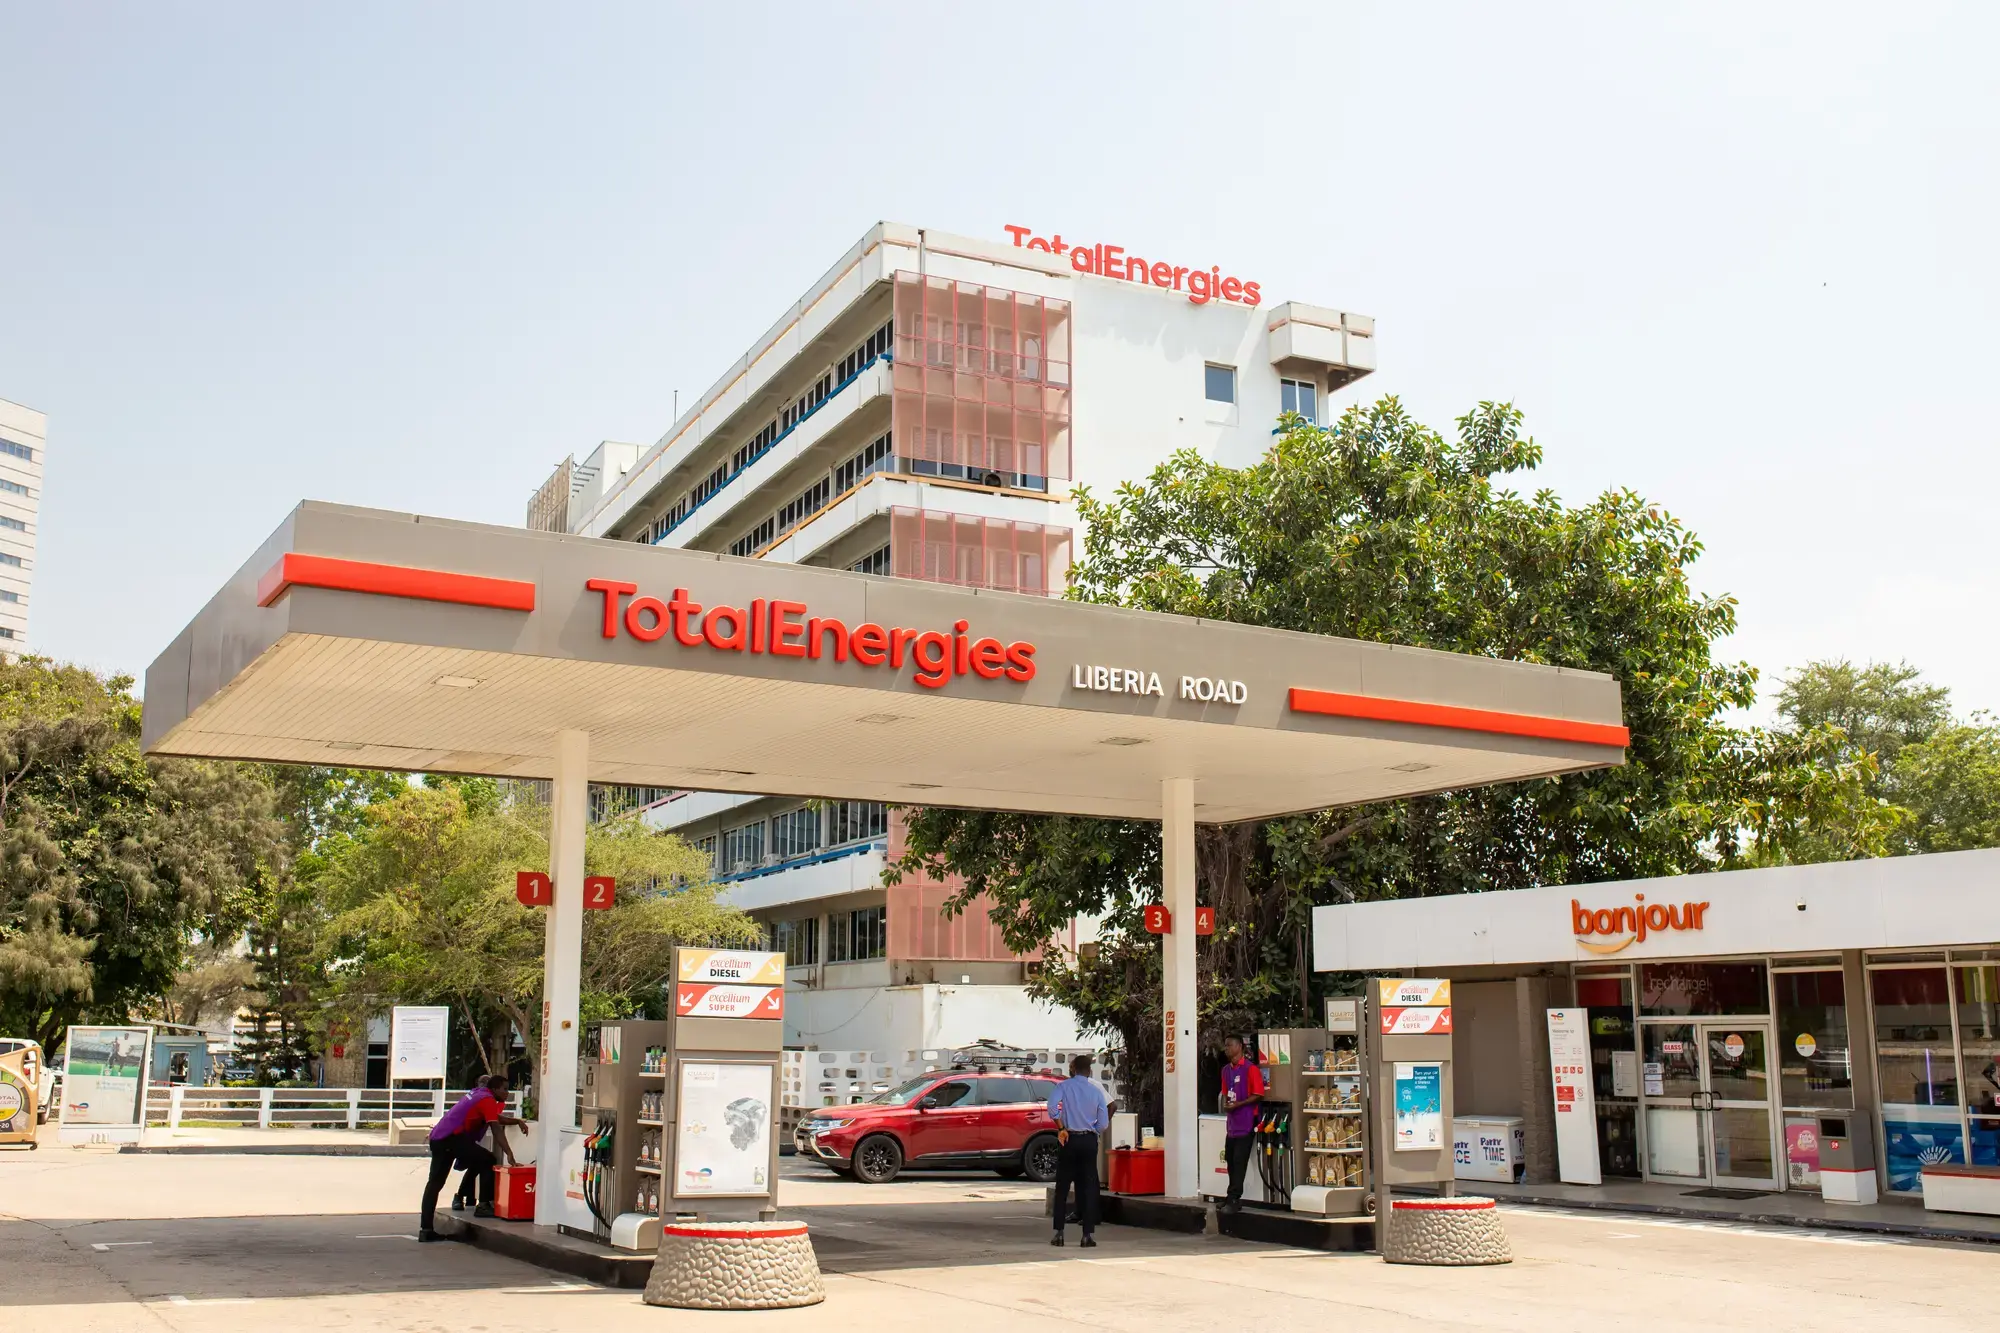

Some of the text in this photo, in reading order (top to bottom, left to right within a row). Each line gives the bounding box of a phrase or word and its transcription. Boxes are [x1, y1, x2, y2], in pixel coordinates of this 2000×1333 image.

[586, 577, 1038, 689] TotalEnergies
[1072, 663, 1248, 705] LIBERIA ROAD
[529, 879, 539, 899] 1
[592, 883, 605, 903] 2
[1153, 911, 1163, 928] 3
[1198, 912, 1209, 929] 4
[1571, 893, 1710, 943] bonjour
[710, 958, 752, 970] excellium
[709, 968, 741, 978] DIESEL
[708, 993, 751, 1004] excellium
[708, 1003, 735, 1012] SUPER
[1483, 1147, 1506, 1162] TIME
